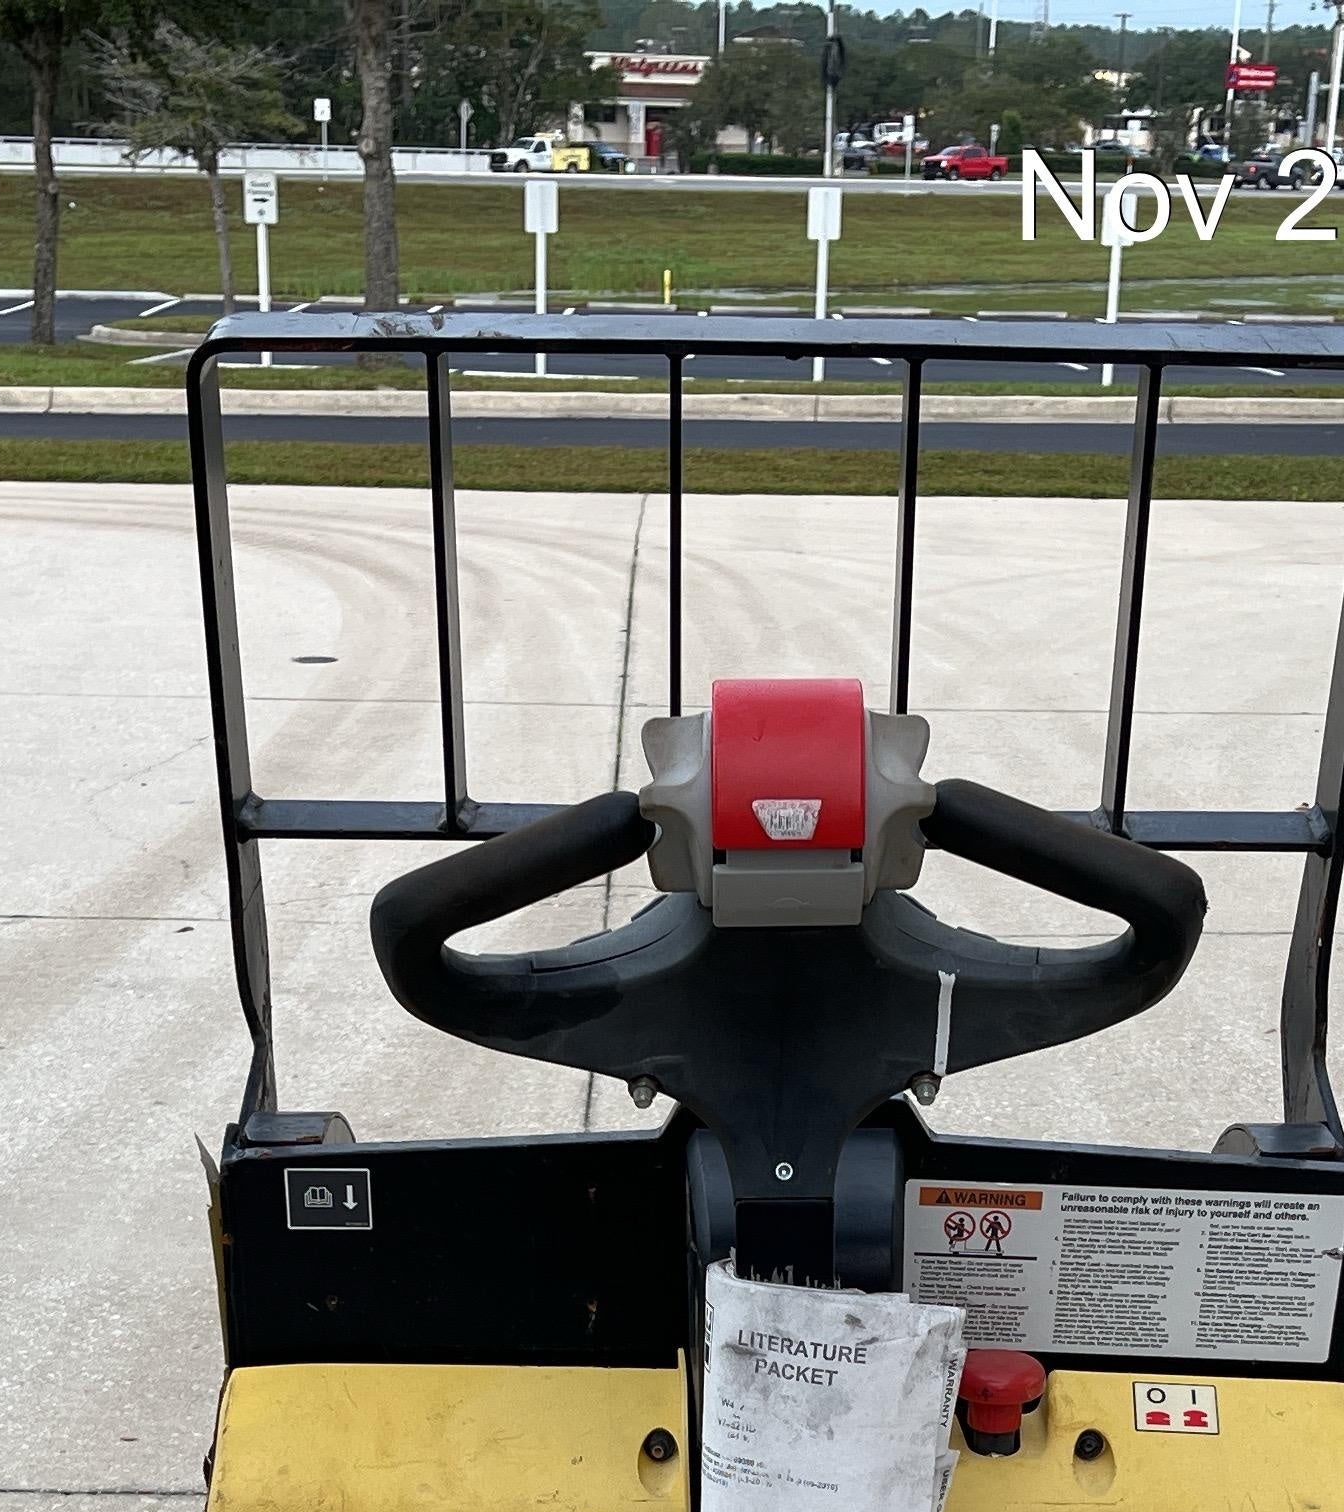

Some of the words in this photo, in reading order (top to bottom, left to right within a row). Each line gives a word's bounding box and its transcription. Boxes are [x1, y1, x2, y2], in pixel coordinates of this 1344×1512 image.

[954, 1191, 1026, 1206] WARNING
[1062, 1192, 1096, 1203] Failure
[1098, 1193, 1109, 1203] to
[1111, 1195, 1148, 1205] comply
[1151, 1195, 1172, 1205] with
[1174, 1196, 1202, 1206] these
[1205, 1197, 1251, 1209] warnings
[1254, 1199, 1271, 1209] will
[1274, 1202, 1305, 1210] create
[1060, 1204, 1128, 1214] unreasonable
[1131, 1206, 1150, 1215] risk
[1153, 1206, 1163, 1215] of
[1166, 1207, 1194, 1218] injury
[1197, 1209, 1207, 1217] to
[1210, 1209, 1251, 1219] yourself
[1253, 1211, 1272, 1219] and
[1275, 1211, 1309, 1221] others.
[737, 1329, 868, 1364] LITERATURE
[754, 1358, 838, 1386] PACKET
[940, 1359, 958, 1428] WARRANTY
